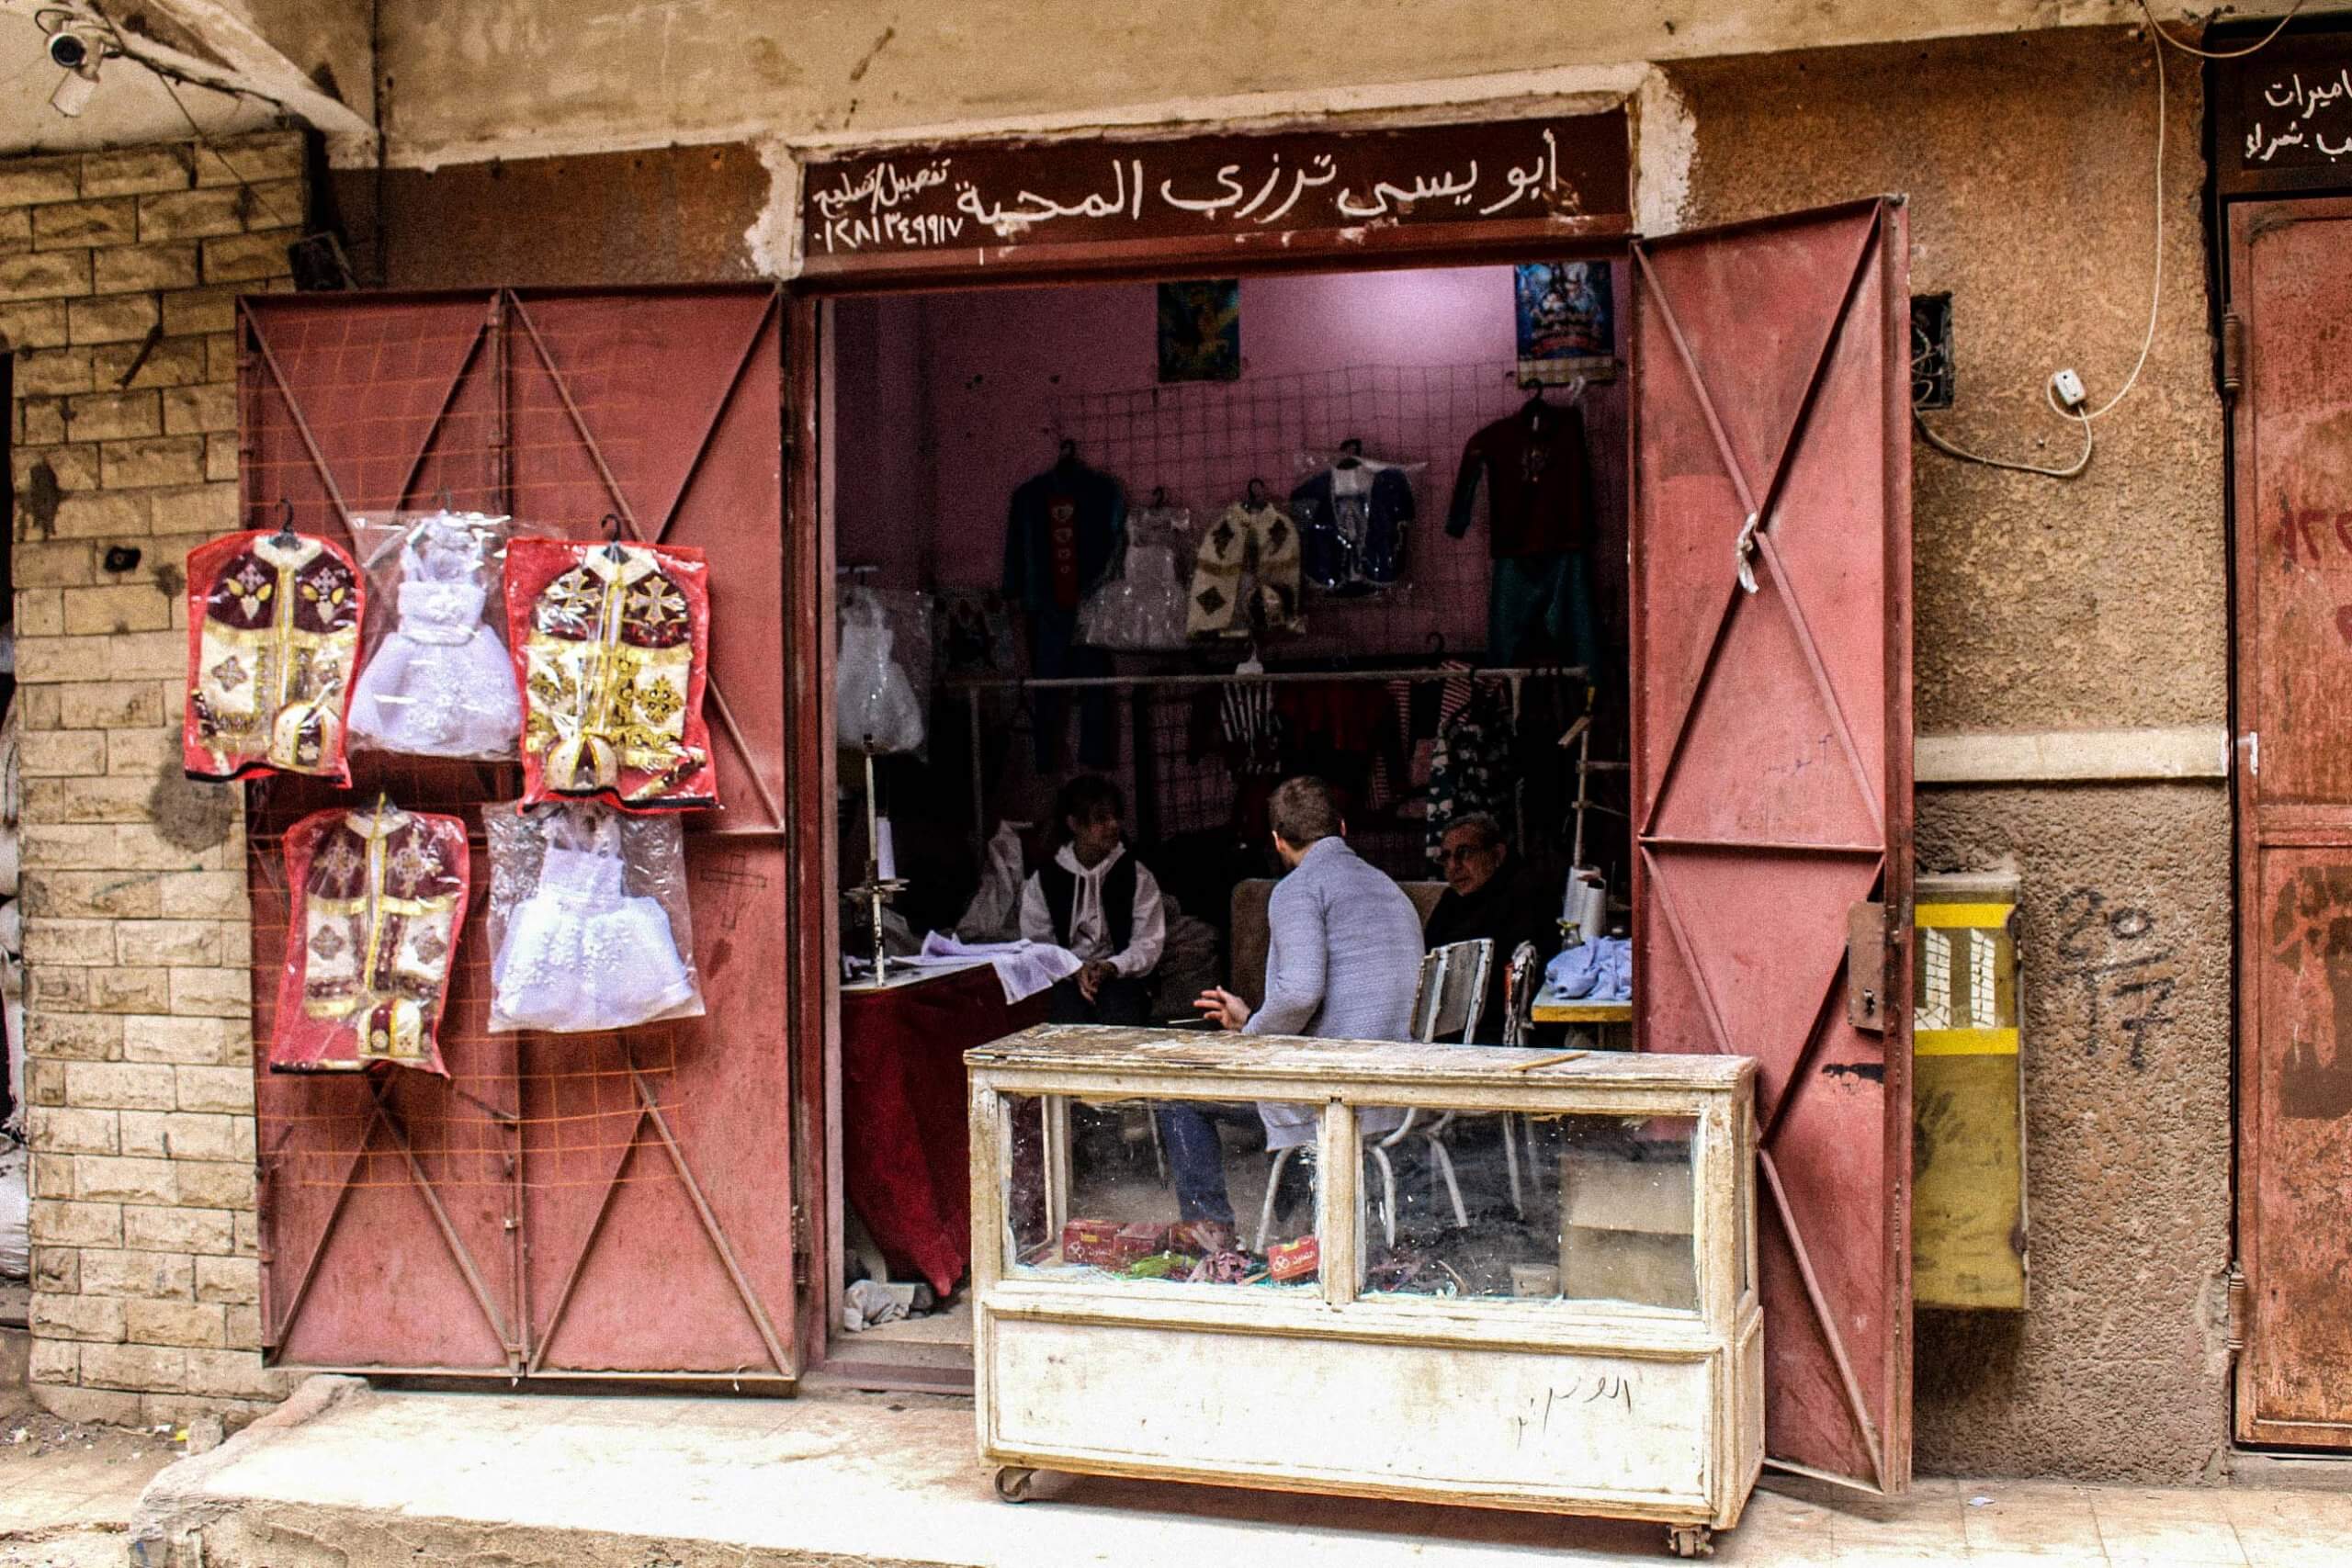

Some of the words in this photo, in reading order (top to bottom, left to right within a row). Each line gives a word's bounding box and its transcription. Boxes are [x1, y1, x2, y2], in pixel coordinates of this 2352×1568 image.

[2265, 69, 2352, 118] اميرات
[956, 159, 1143, 231] المحبة
[1478, 129, 1557, 215] أبو
